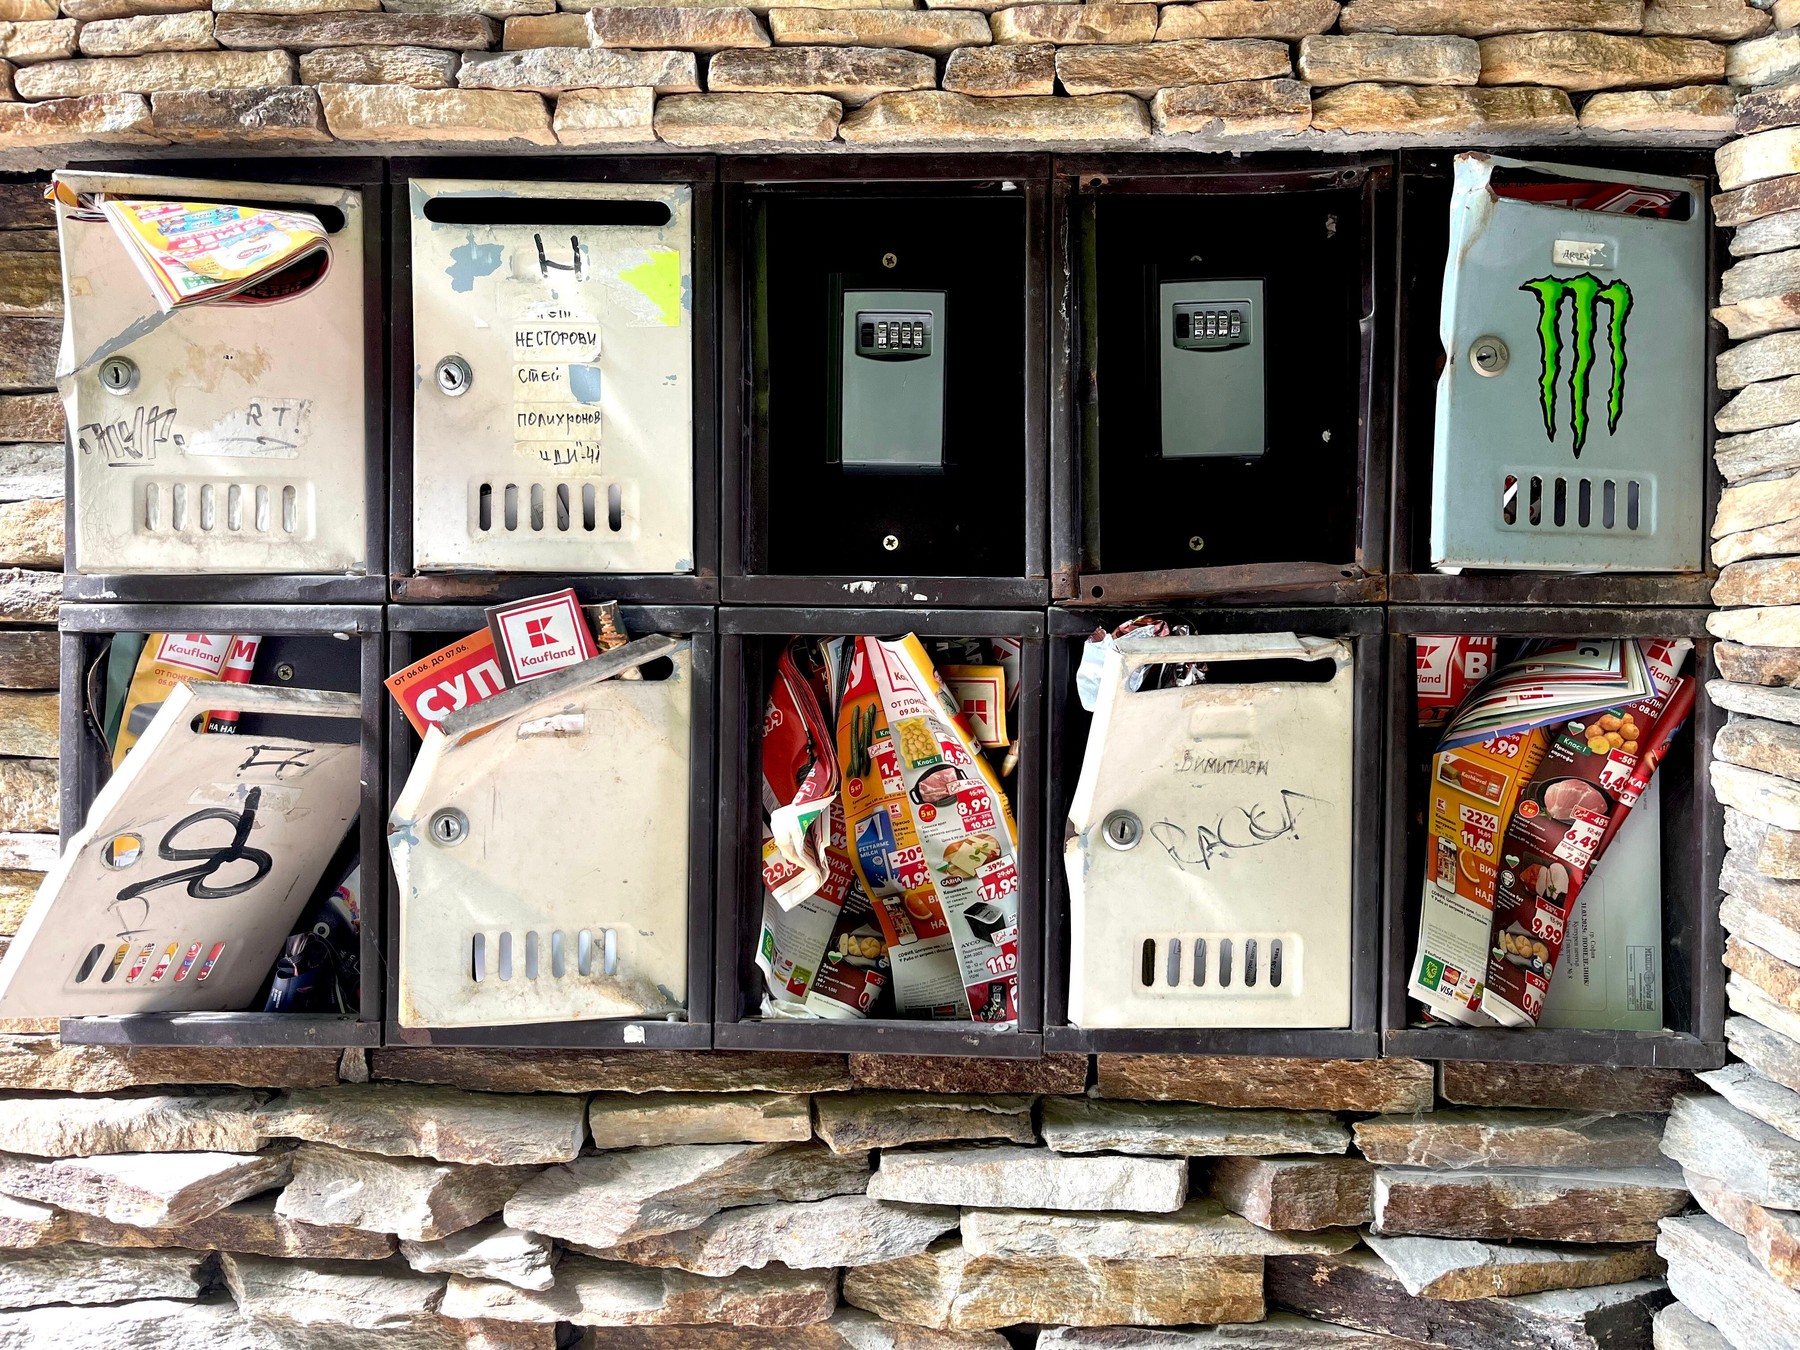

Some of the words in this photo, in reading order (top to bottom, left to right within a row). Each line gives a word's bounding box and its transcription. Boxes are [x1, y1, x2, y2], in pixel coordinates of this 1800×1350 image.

[168, 643, 221, 664] Kaufland
[520, 644, 577, 668] Kaufland
[394, 675, 407, 686] ОТ
[430, 655, 445, 668] ДО
[944, 749, 972, 766] 4,99
[957, 796, 991, 816] 8,99
[1621, 792, 1635, 803] ОТ
[971, 818, 994, 830] 10,99
[1461, 809, 1496, 830] -22%
[1461, 830, 1494, 856] 11,49
[1565, 829, 1599, 851] 6,49
[985, 860, 1006, 873] -39%
[1566, 852, 1586, 867] 7,99
[977, 875, 1018, 902] 17,99
[1475, 887, 1494, 906] НАД
[1532, 917, 1564, 945] 9,99
[1440, 984, 1454, 998] VISA
